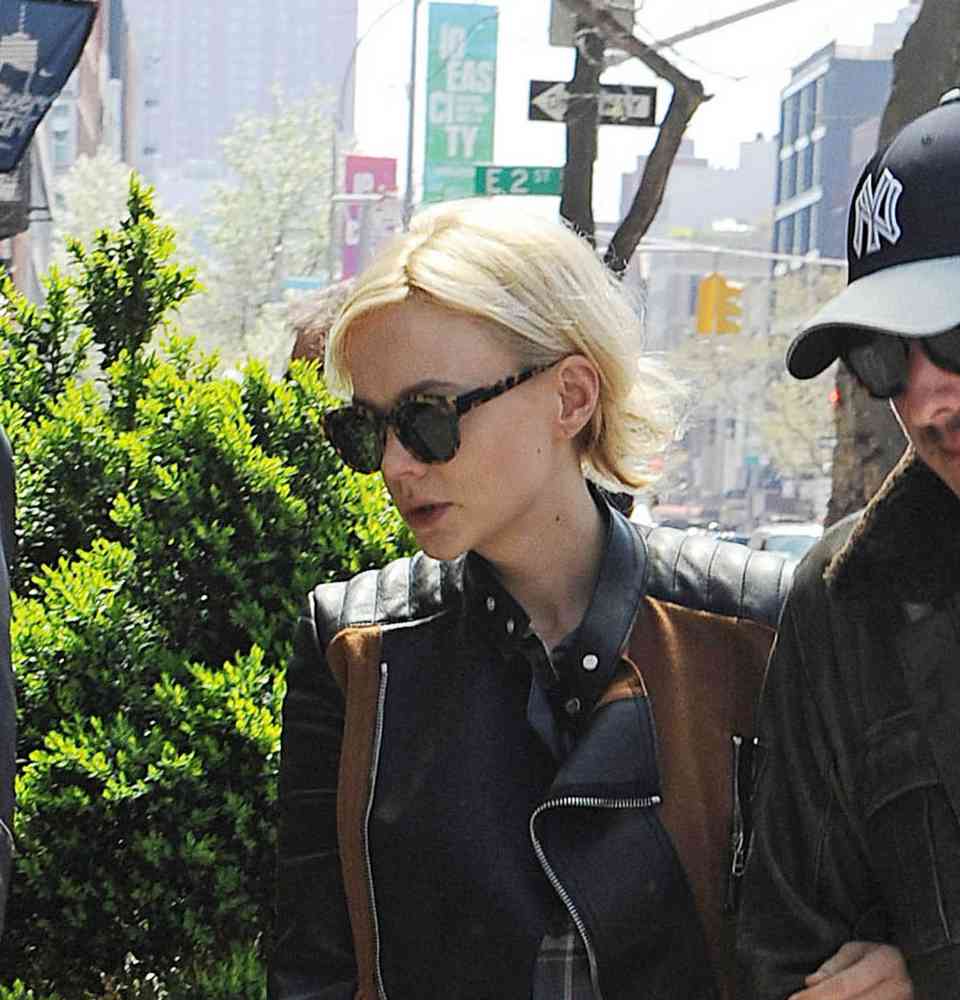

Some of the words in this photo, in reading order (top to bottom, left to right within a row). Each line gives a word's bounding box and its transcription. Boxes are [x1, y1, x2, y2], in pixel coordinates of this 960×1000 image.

[447, 60, 494, 92] EAS
[446, 126, 479, 159] TY
[486, 168, 502, 193] E
[510, 168, 529, 193] 2
[853, 167, 902, 259] NY
